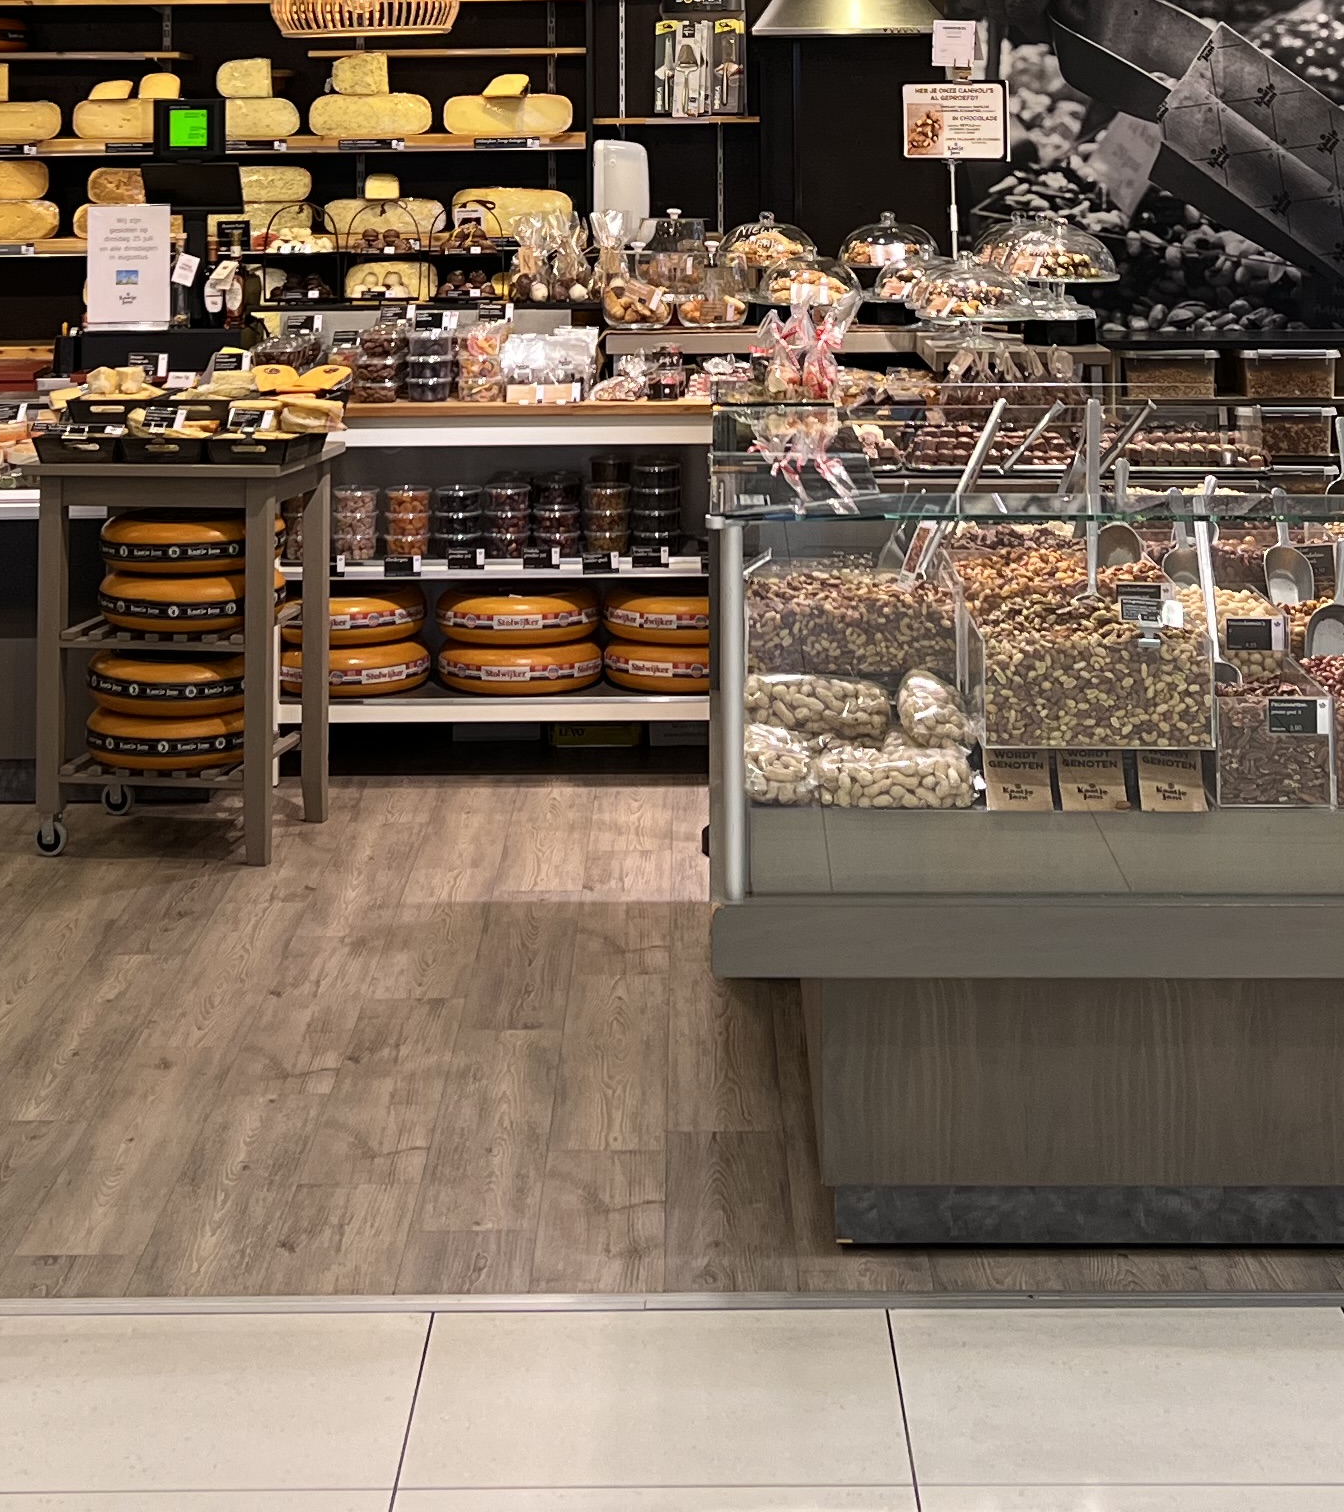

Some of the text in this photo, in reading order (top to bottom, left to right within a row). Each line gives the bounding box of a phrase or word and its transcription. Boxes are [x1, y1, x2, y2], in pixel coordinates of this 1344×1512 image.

[496, 617, 542, 629] Stolwijker
[485, 669, 527, 679] Stolwijker
[631, 663, 670, 675] Stolwijker
[366, 669, 404, 681] Stolwijker
[994, 750, 1038, 759] WORDT
[988, 760, 1044, 770] GENOTEN
[1062, 759, 1118, 769] GENOTEN
[1142, 756, 1197, 771] GENOTEN
